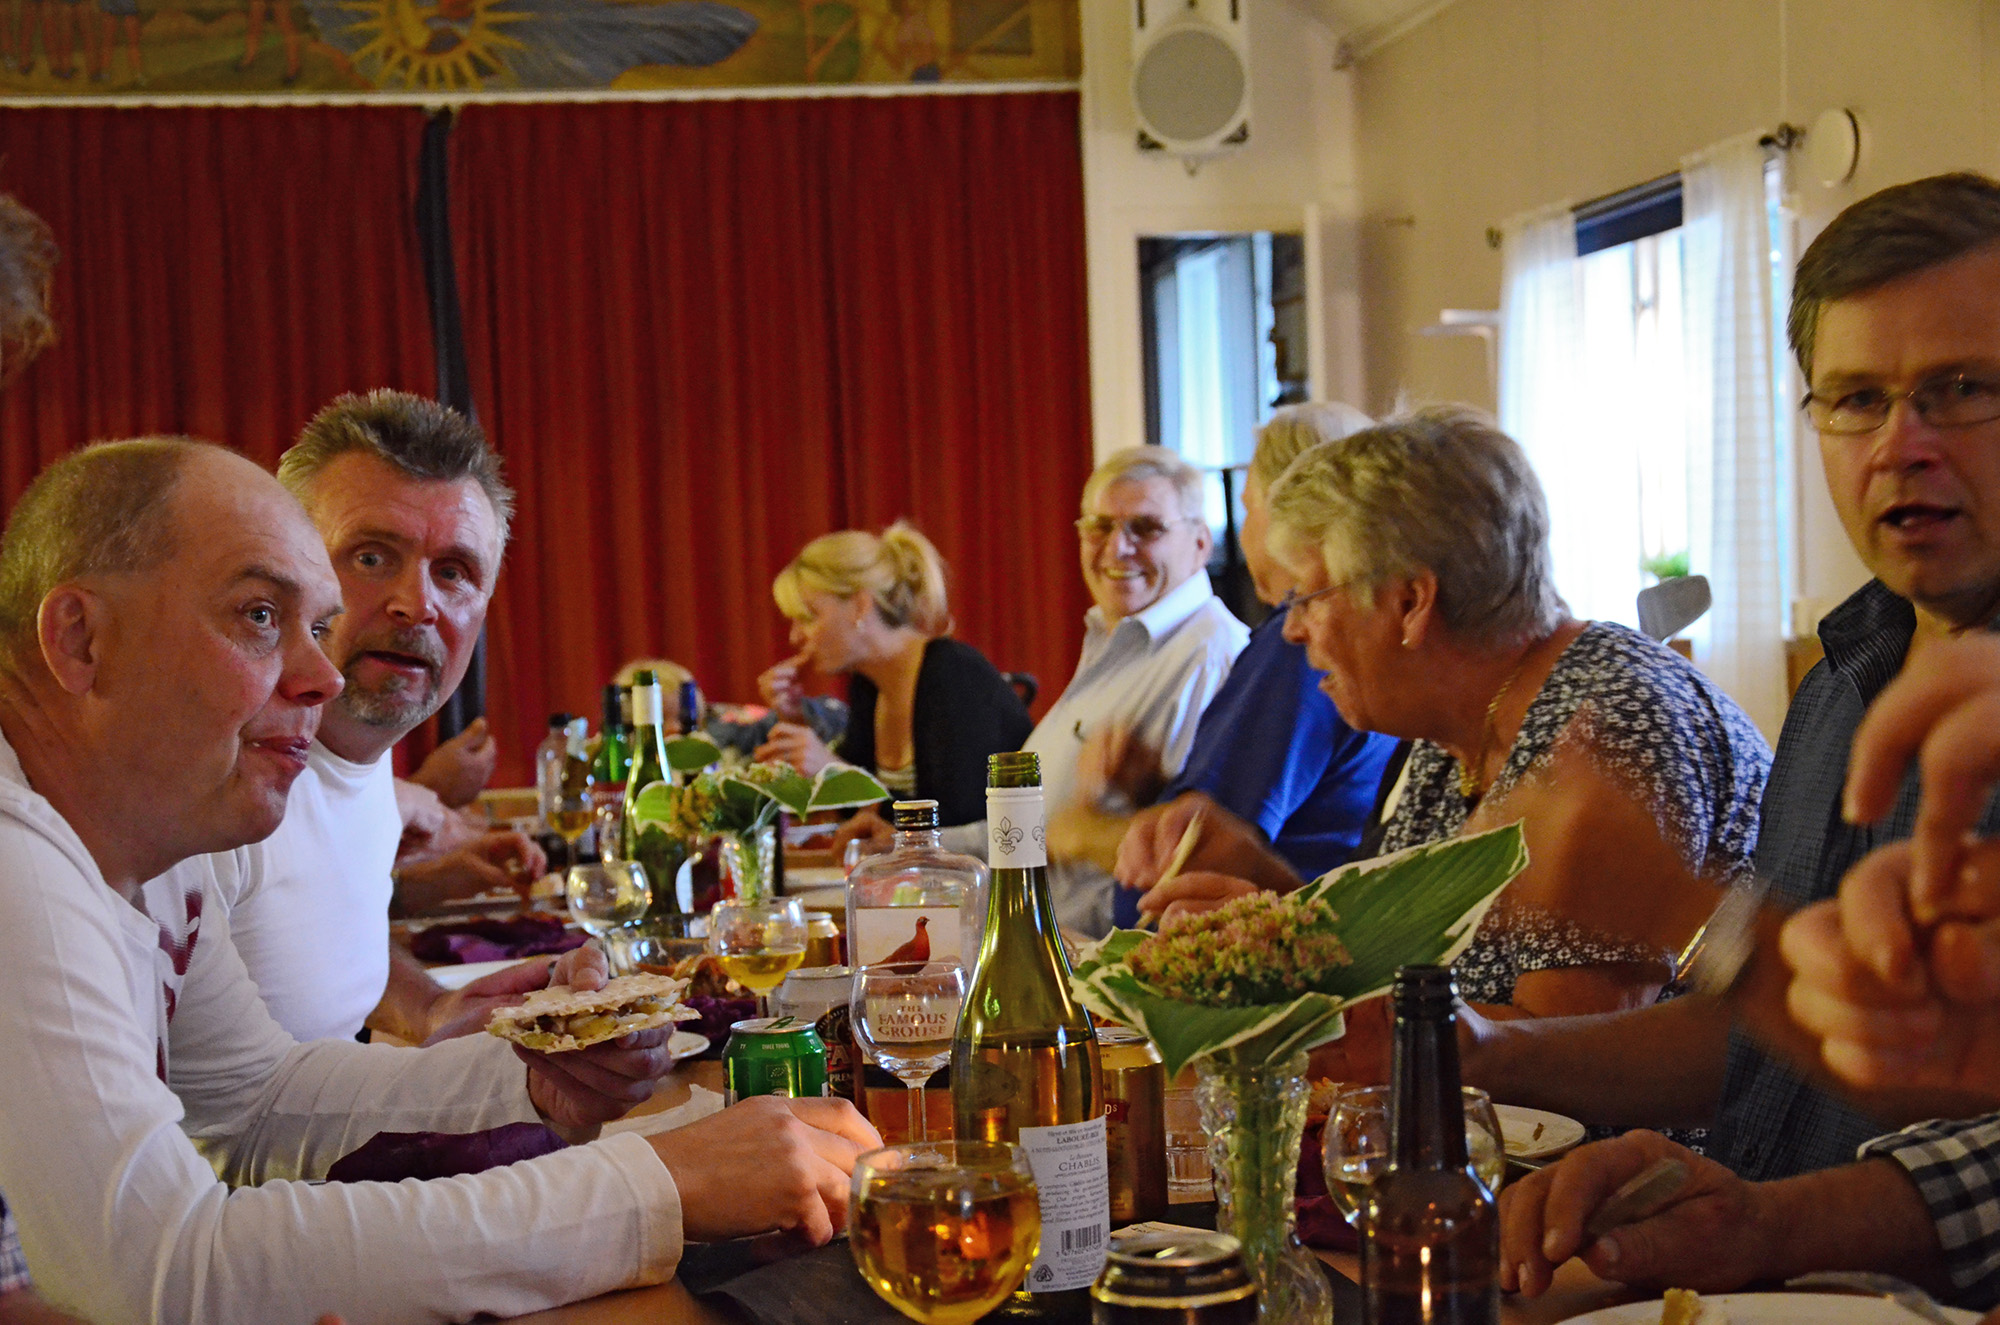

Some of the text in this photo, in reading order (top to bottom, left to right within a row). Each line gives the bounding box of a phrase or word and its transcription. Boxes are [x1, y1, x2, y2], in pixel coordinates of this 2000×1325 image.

[878, 1012, 947, 1025] FAMOUS
[878, 1025, 946, 1037] GROUSE
[1058, 1157, 1100, 1172] CHABLIS
